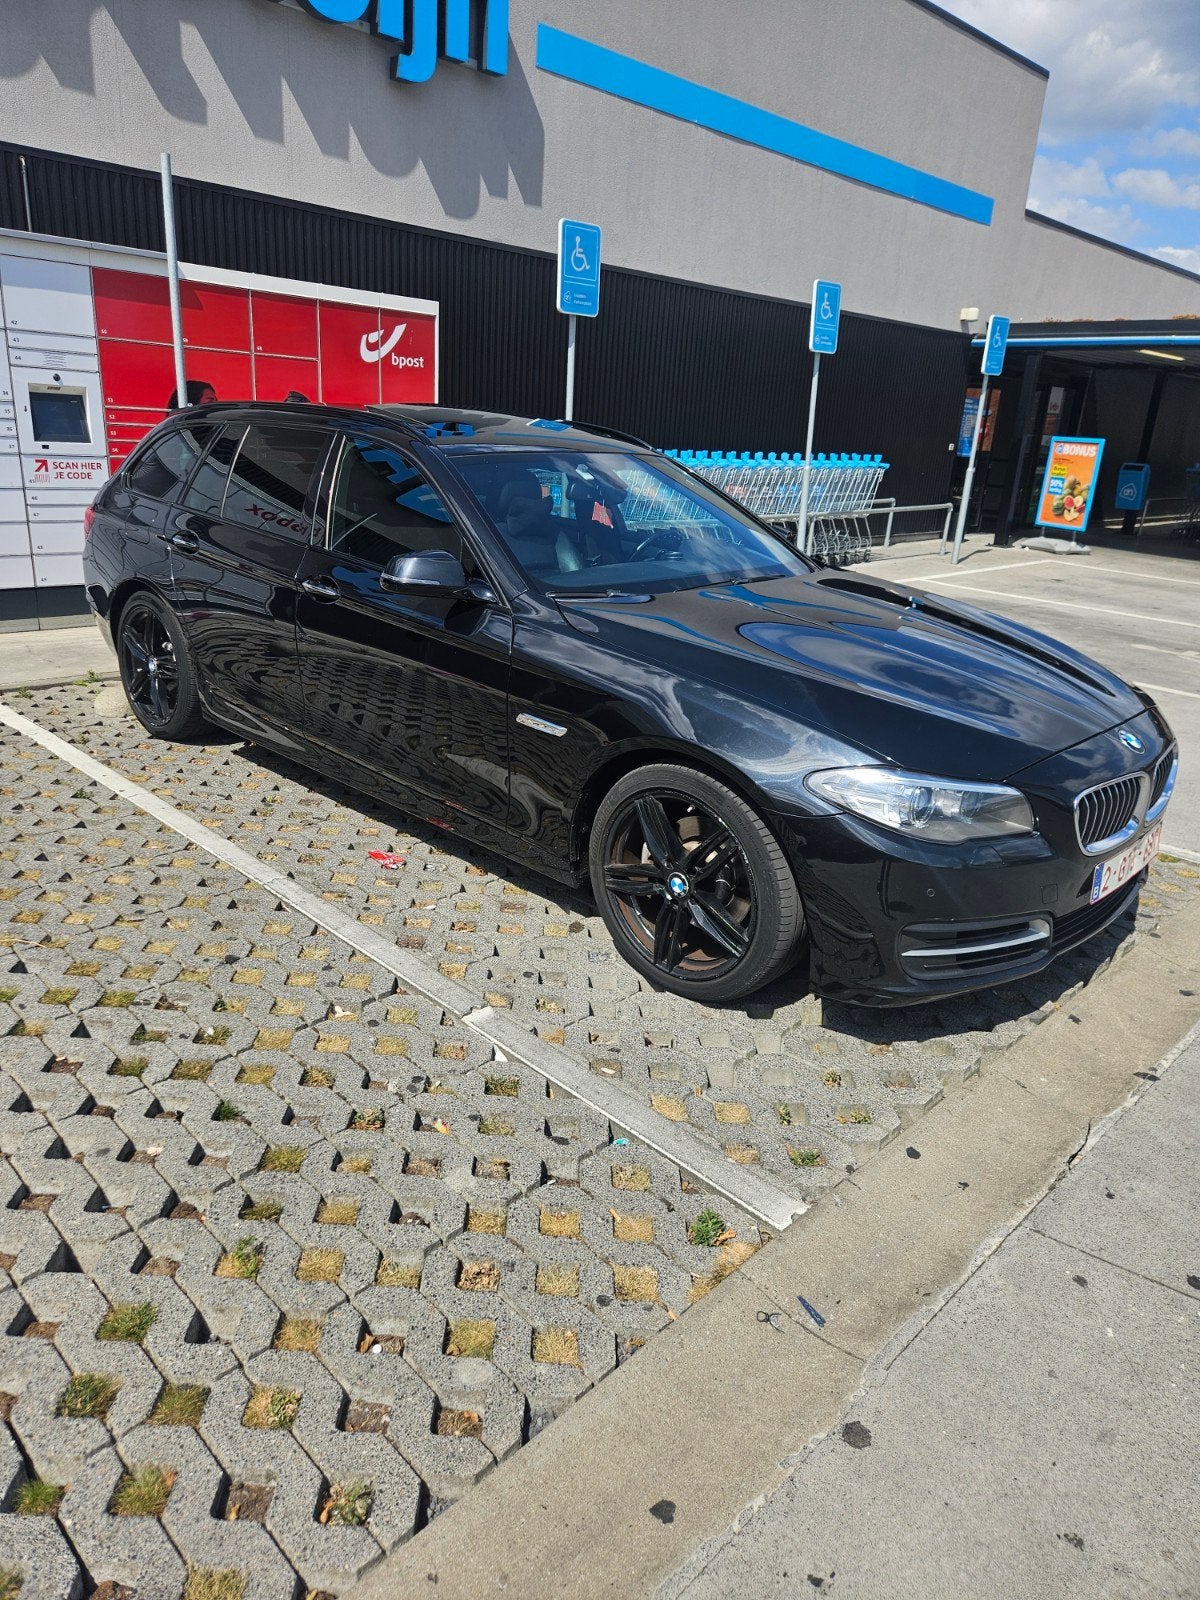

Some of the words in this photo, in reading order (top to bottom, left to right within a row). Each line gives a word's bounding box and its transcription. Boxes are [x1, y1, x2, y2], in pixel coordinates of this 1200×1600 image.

[391, 352, 425, 369] bpost
[1063, 443, 1097, 458] BONUS
[52, 461, 78, 470] SCAN
[81, 461, 103, 471] HIER
[53, 471, 65, 480] JE
[67, 471, 93, 480] CODE
